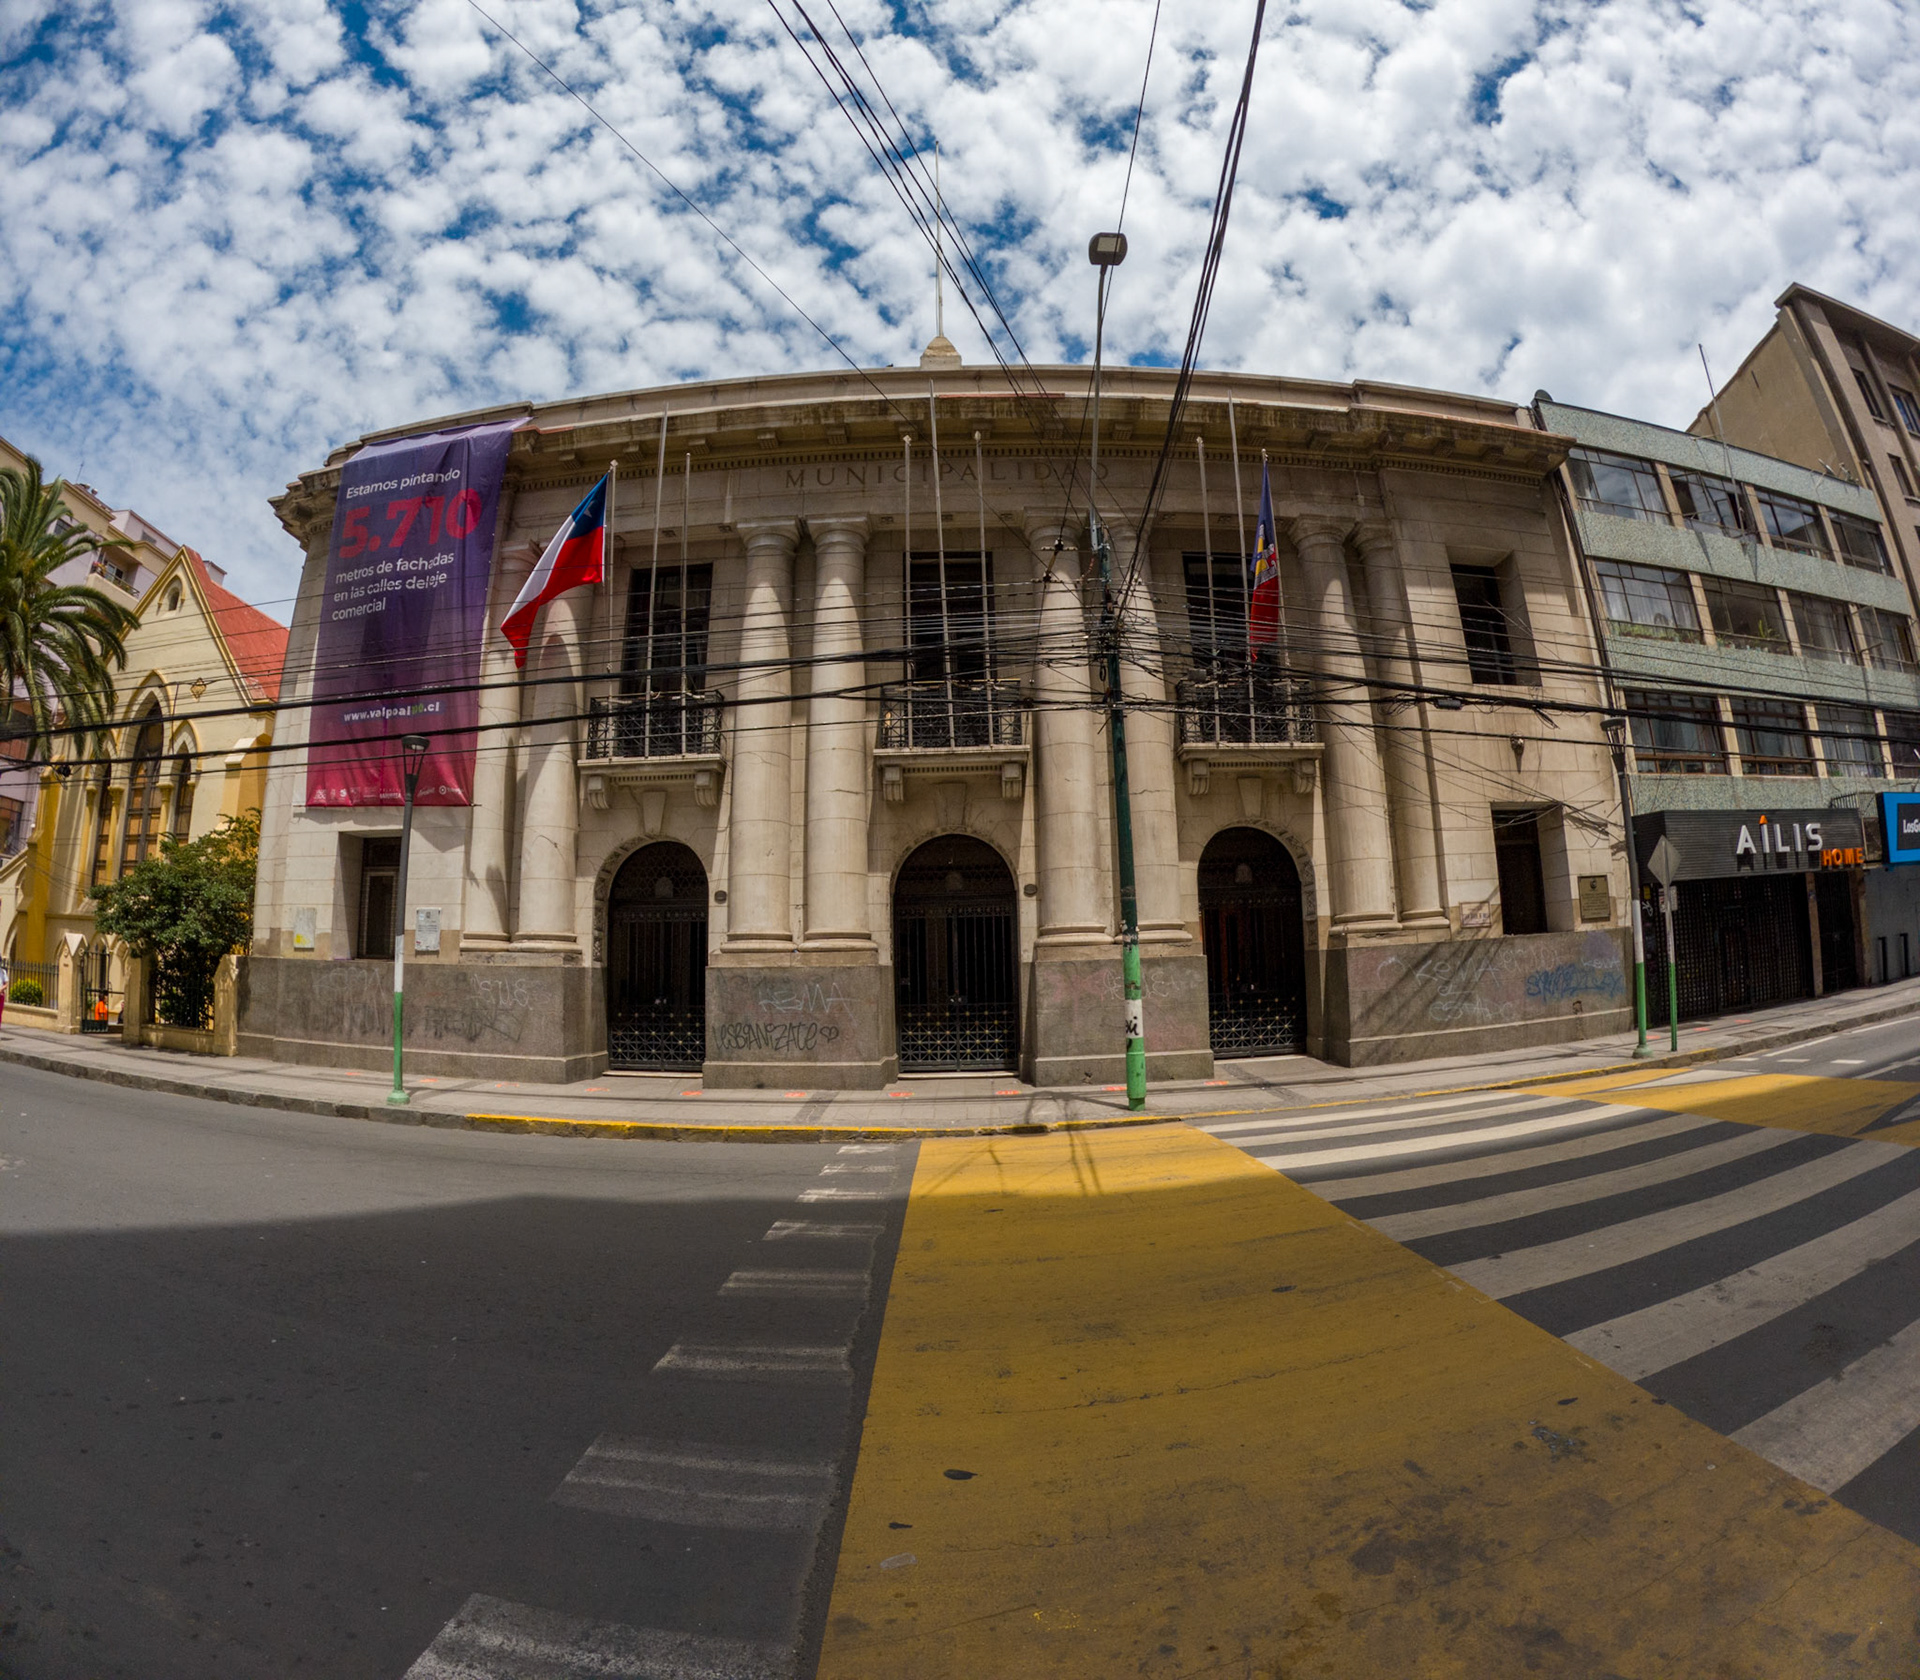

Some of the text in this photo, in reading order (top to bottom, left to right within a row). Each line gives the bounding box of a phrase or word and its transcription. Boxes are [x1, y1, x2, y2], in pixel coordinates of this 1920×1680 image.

[346, 468, 461, 499] Estamos pintando
[785, 461, 1109, 489] MUNICIPALIDAD
[339, 488, 482, 559] 5.710
[335, 552, 455, 584] metros de fachadas
[333, 591, 348, 603] en
[350, 586, 365, 600] las
[367, 578, 402, 595] calles
[332, 597, 387, 621] comercial
[1736, 821, 1824, 855] AILIS
[1823, 847, 1864, 867] HOME
